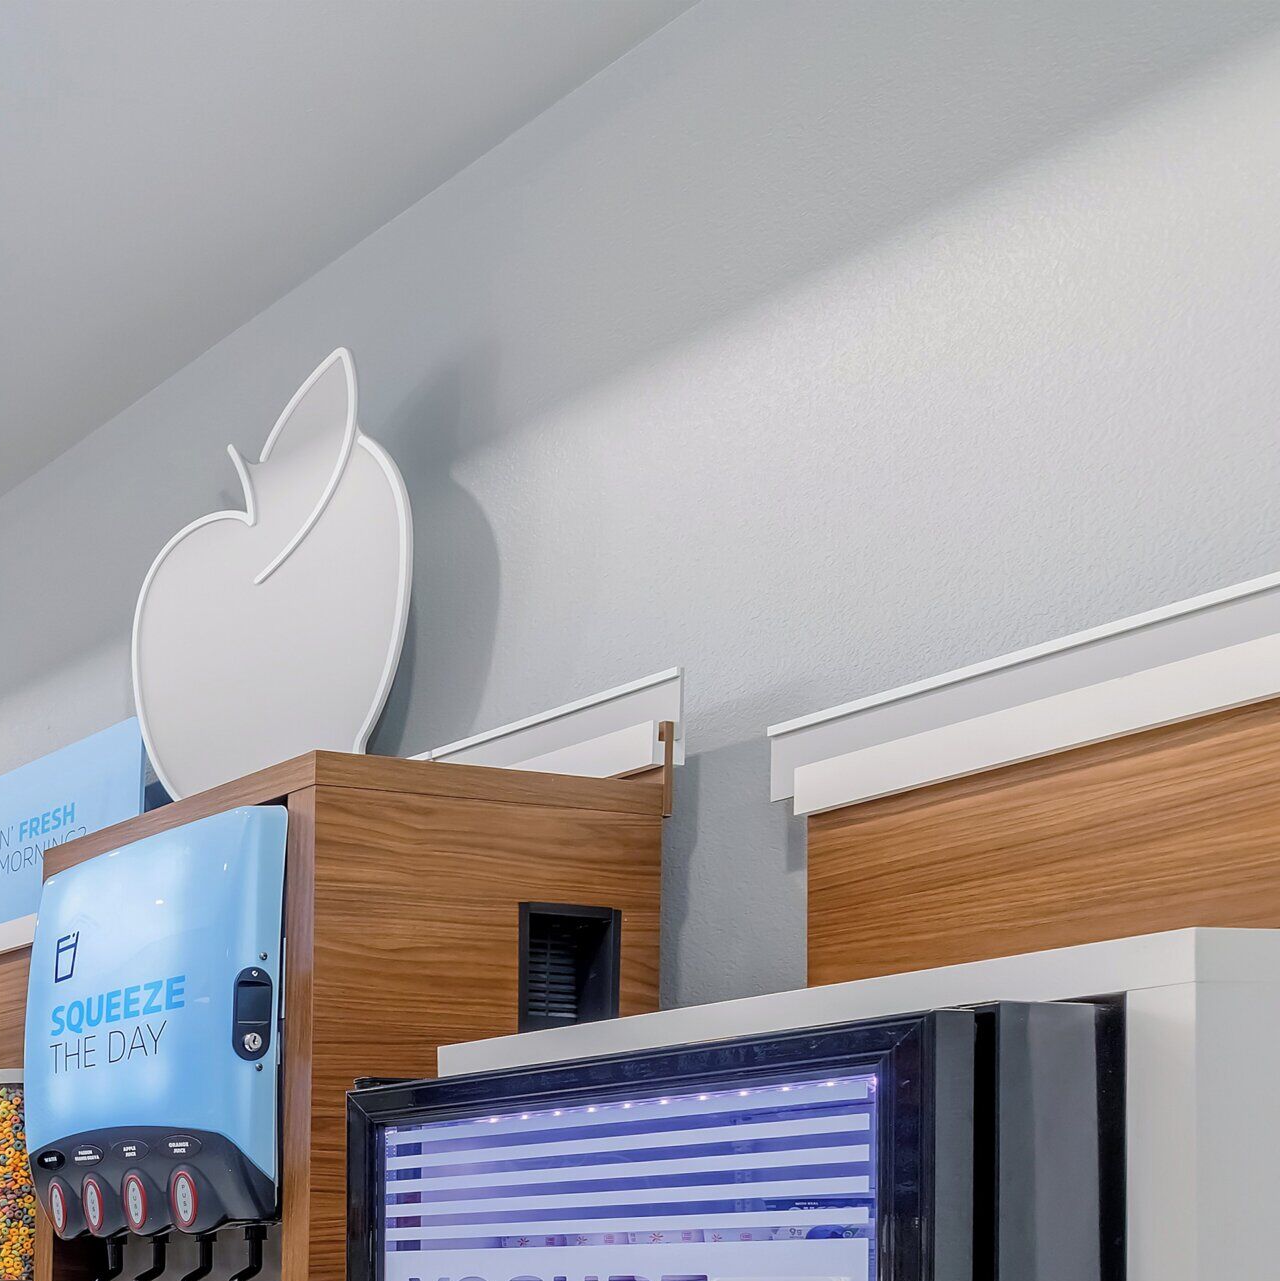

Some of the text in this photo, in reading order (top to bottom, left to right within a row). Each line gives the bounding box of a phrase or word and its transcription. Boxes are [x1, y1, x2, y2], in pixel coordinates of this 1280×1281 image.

[18, 802, 76, 842] FRESH
[50, 975, 186, 1037] SQUEEZE
[50, 1020, 167, 1074] THE DAY
